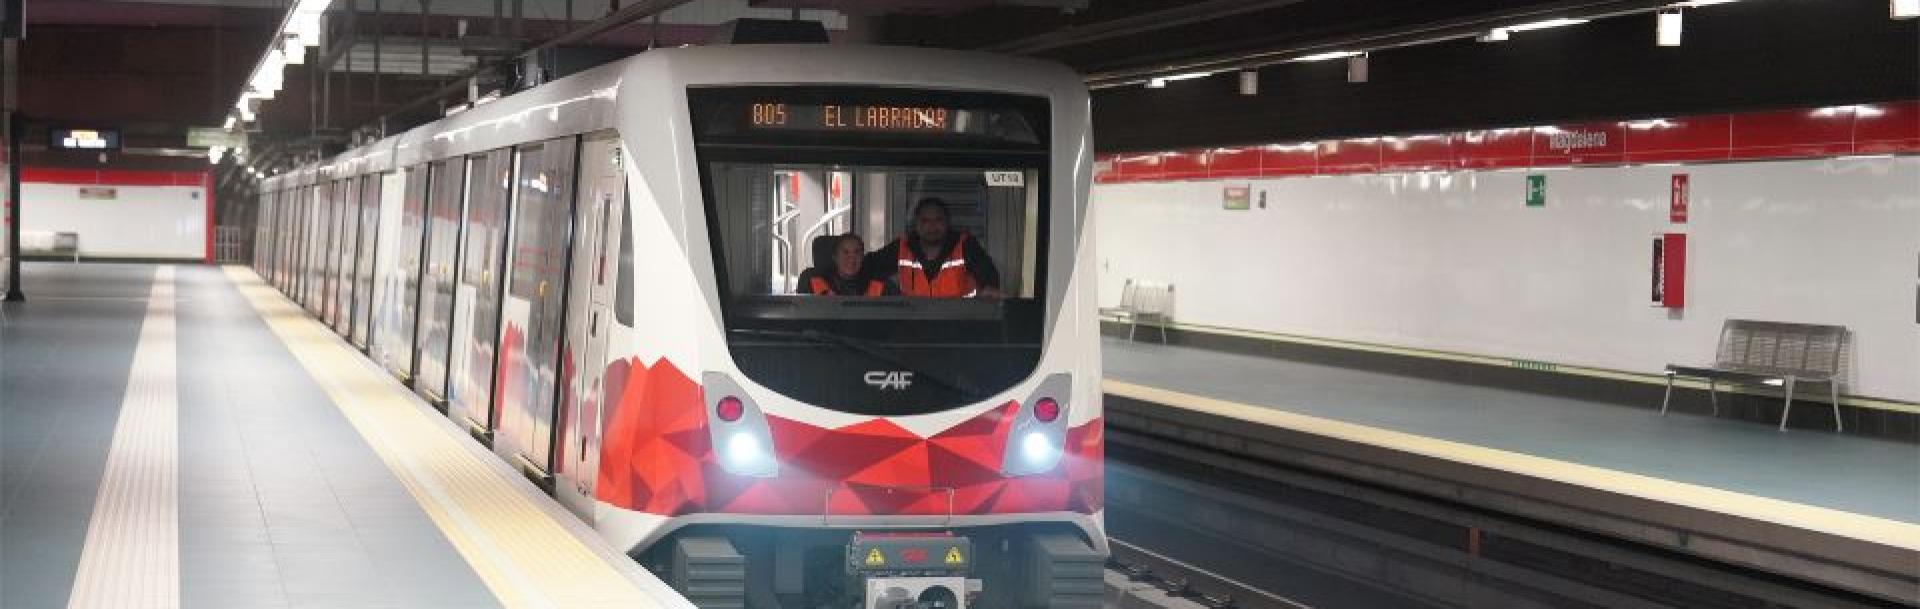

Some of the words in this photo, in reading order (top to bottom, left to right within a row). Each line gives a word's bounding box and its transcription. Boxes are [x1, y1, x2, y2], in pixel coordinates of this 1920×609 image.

[825, 105, 847, 127] EL
[855, 106, 946, 129] LABRADOR
[864, 370, 913, 390] CAF
